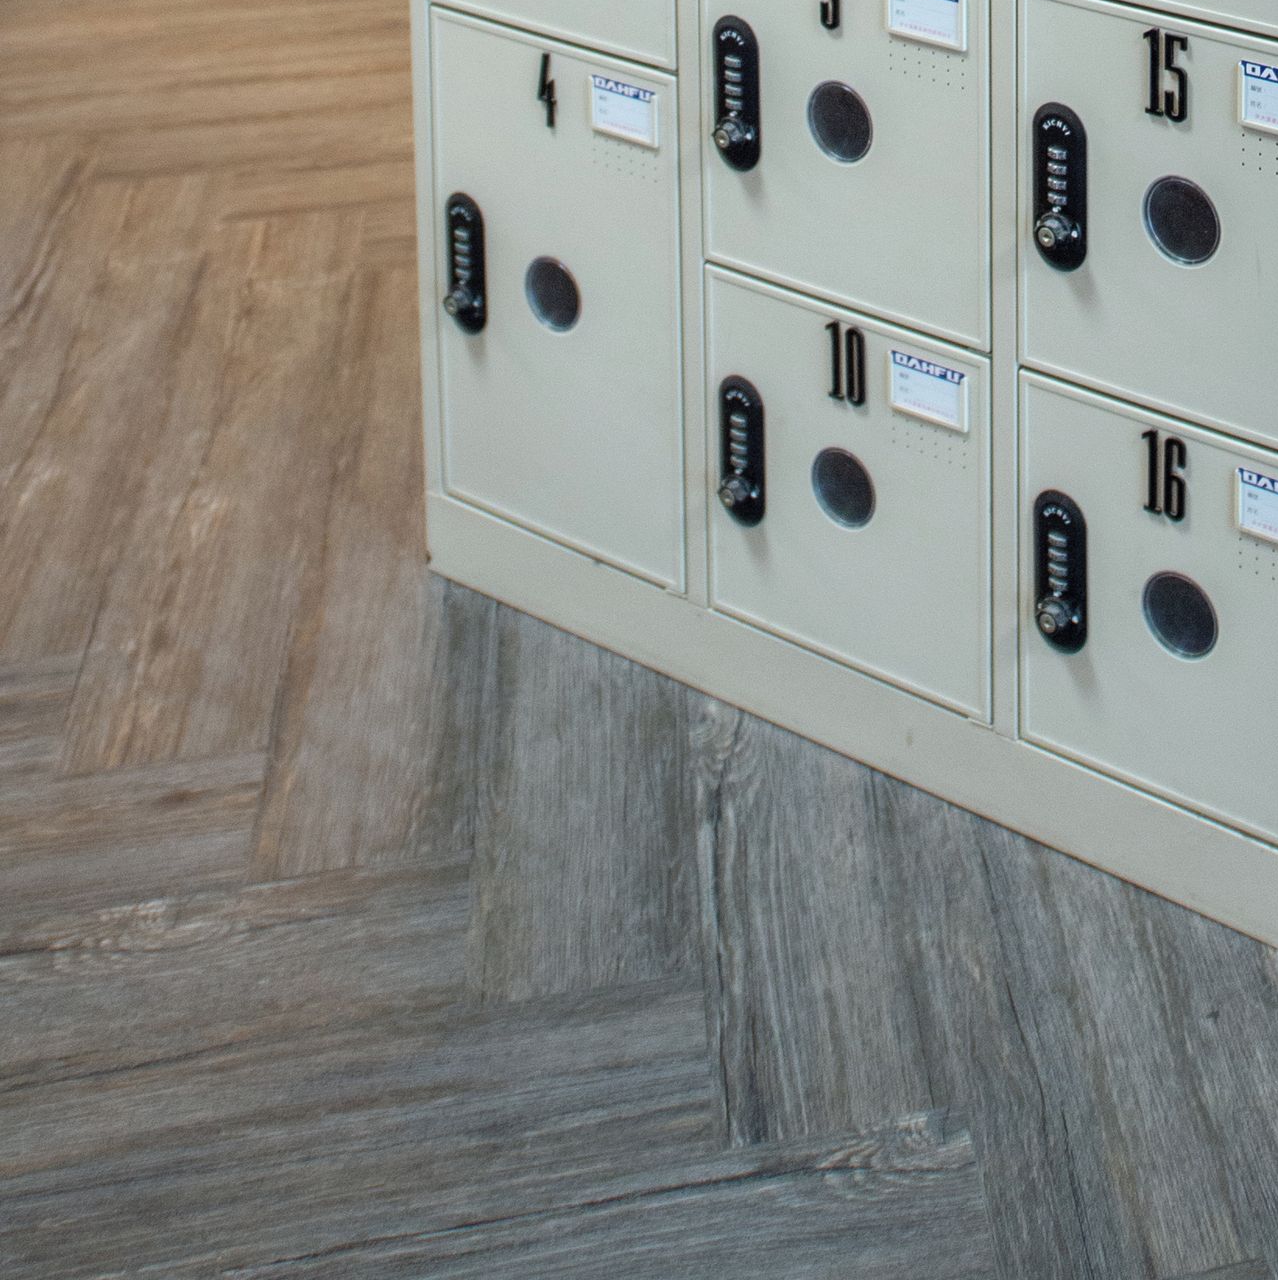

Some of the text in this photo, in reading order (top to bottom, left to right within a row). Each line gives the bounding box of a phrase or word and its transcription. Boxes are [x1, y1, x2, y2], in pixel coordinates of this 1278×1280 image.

[538, 54, 556, 127] 4
[594, 77, 650, 100] DAHFU
[1143, 28, 1188, 123] 15
[1043, 120, 1070, 136] KICHYI
[826, 321, 866, 407] 10
[895, 352, 960, 383] DAHFU
[1142, 430, 1186, 522] 16
